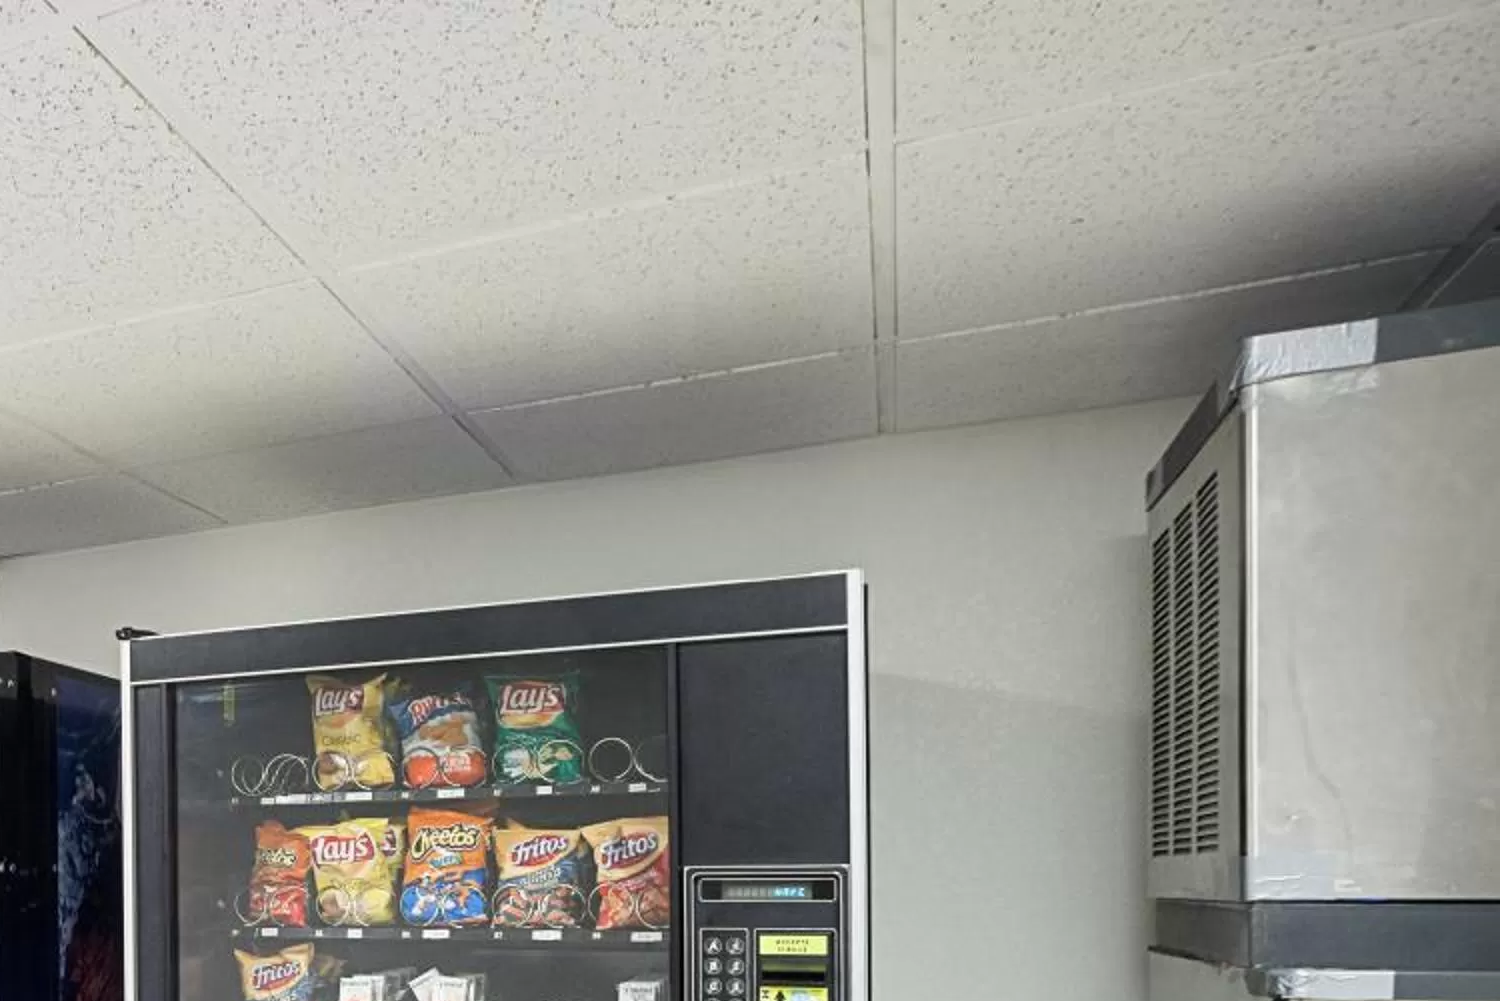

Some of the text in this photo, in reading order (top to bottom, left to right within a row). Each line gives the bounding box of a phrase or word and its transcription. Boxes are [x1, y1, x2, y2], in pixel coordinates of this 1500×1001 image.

[500, 684, 560, 713] Lay's
[311, 835, 370, 866] Lay's
[411, 825, 479, 858] Cheetos
[512, 835, 569, 865] Fritos
[600, 832, 658, 869] Fritos
